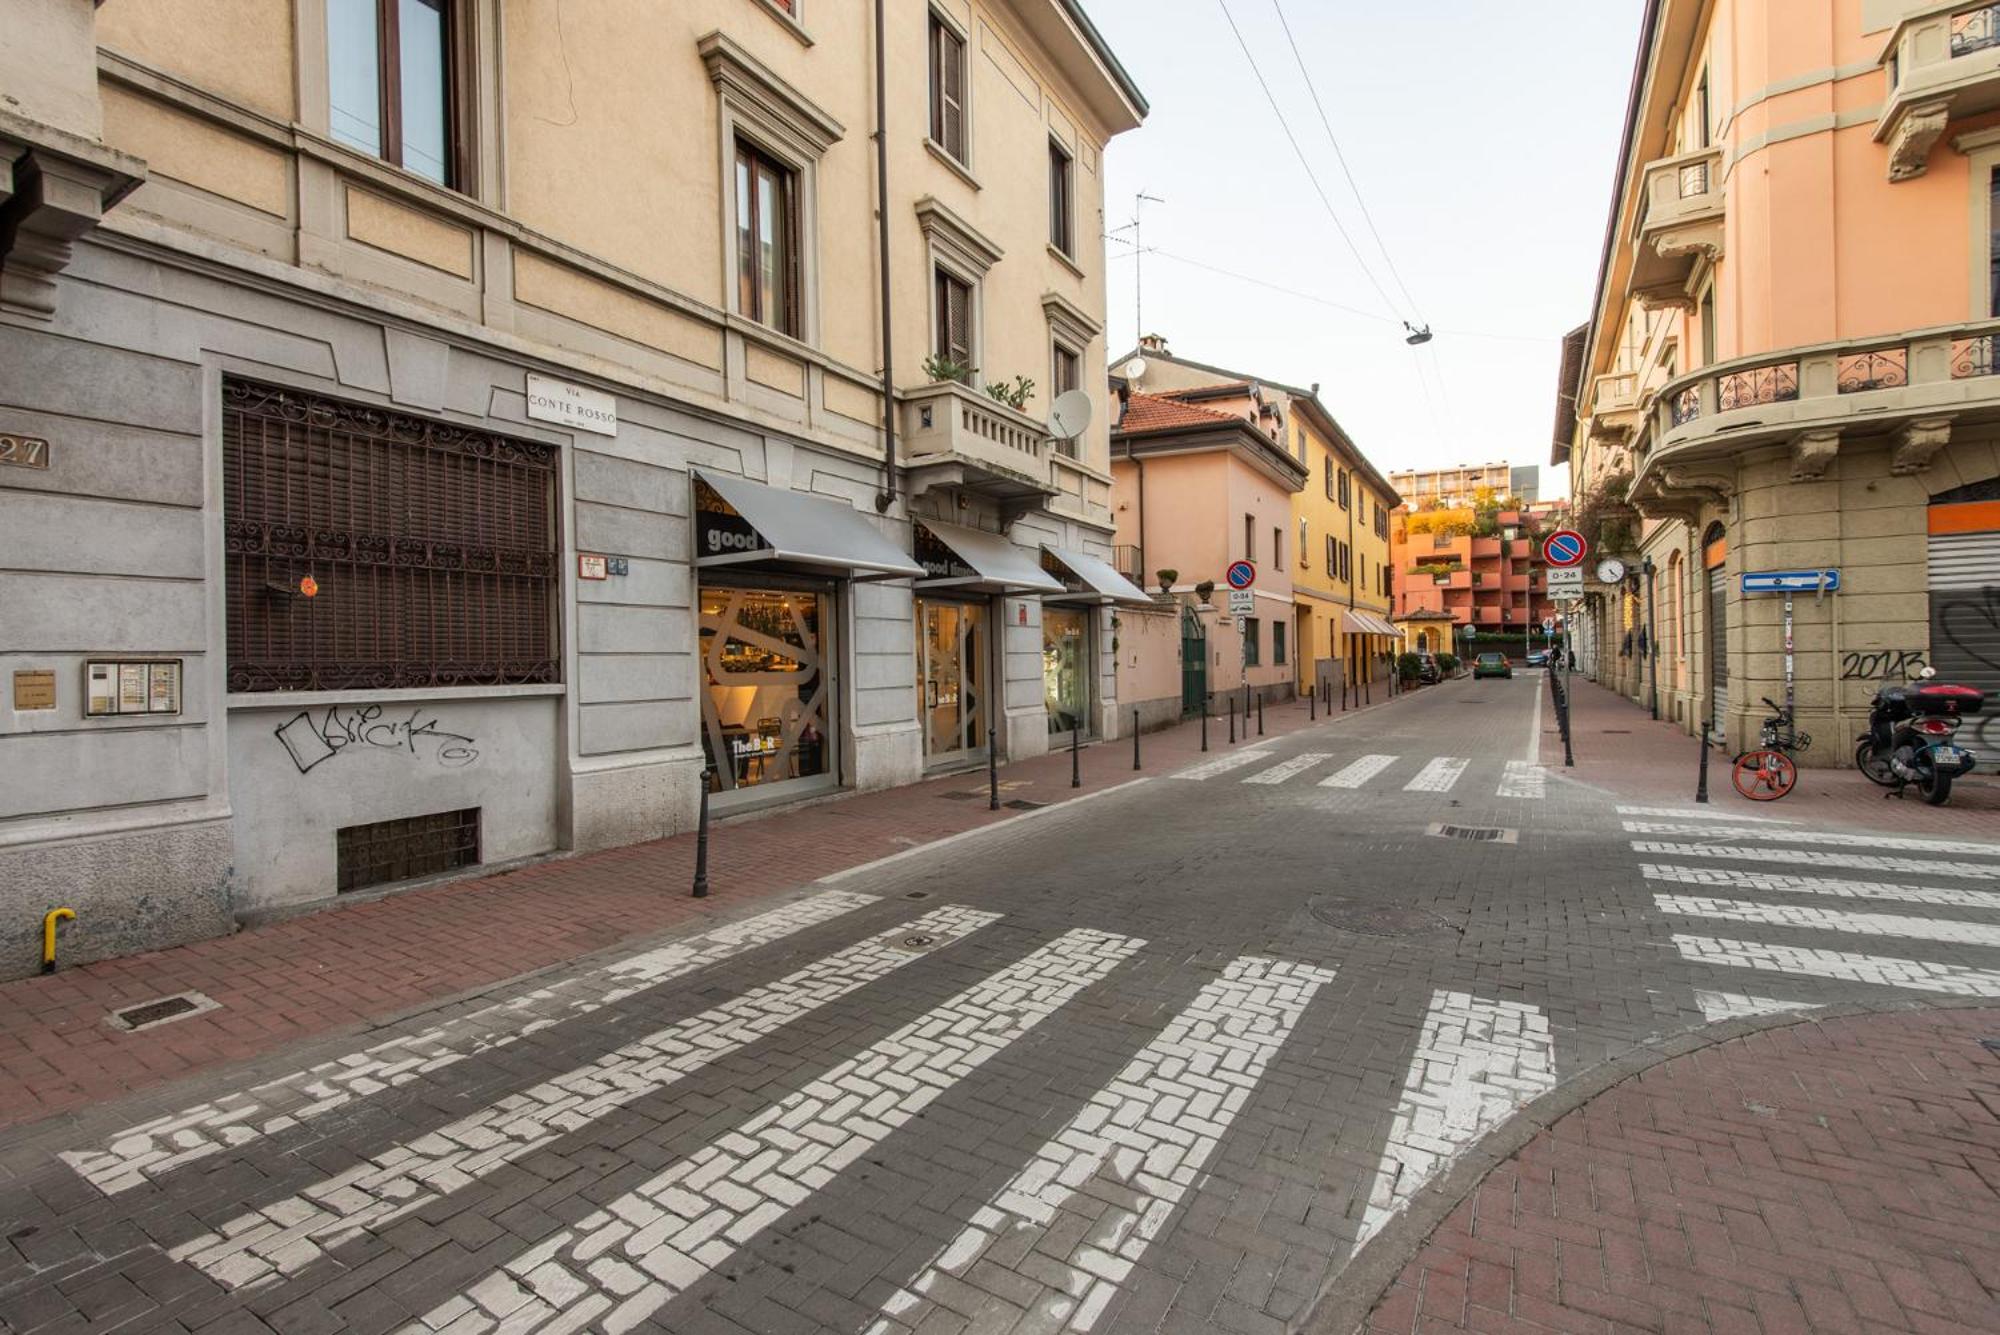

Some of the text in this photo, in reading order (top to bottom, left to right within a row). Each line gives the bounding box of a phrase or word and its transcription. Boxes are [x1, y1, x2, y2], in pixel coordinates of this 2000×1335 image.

[566, 387, 581, 397] VIA
[528, 394, 572, 414] CONTE
[577, 406, 616, 424] ROSSO
[0, 437, 42, 464] 27
[708, 529, 758, 551] good
[923, 560, 948, 575] good
[732, 739, 753, 754] The
